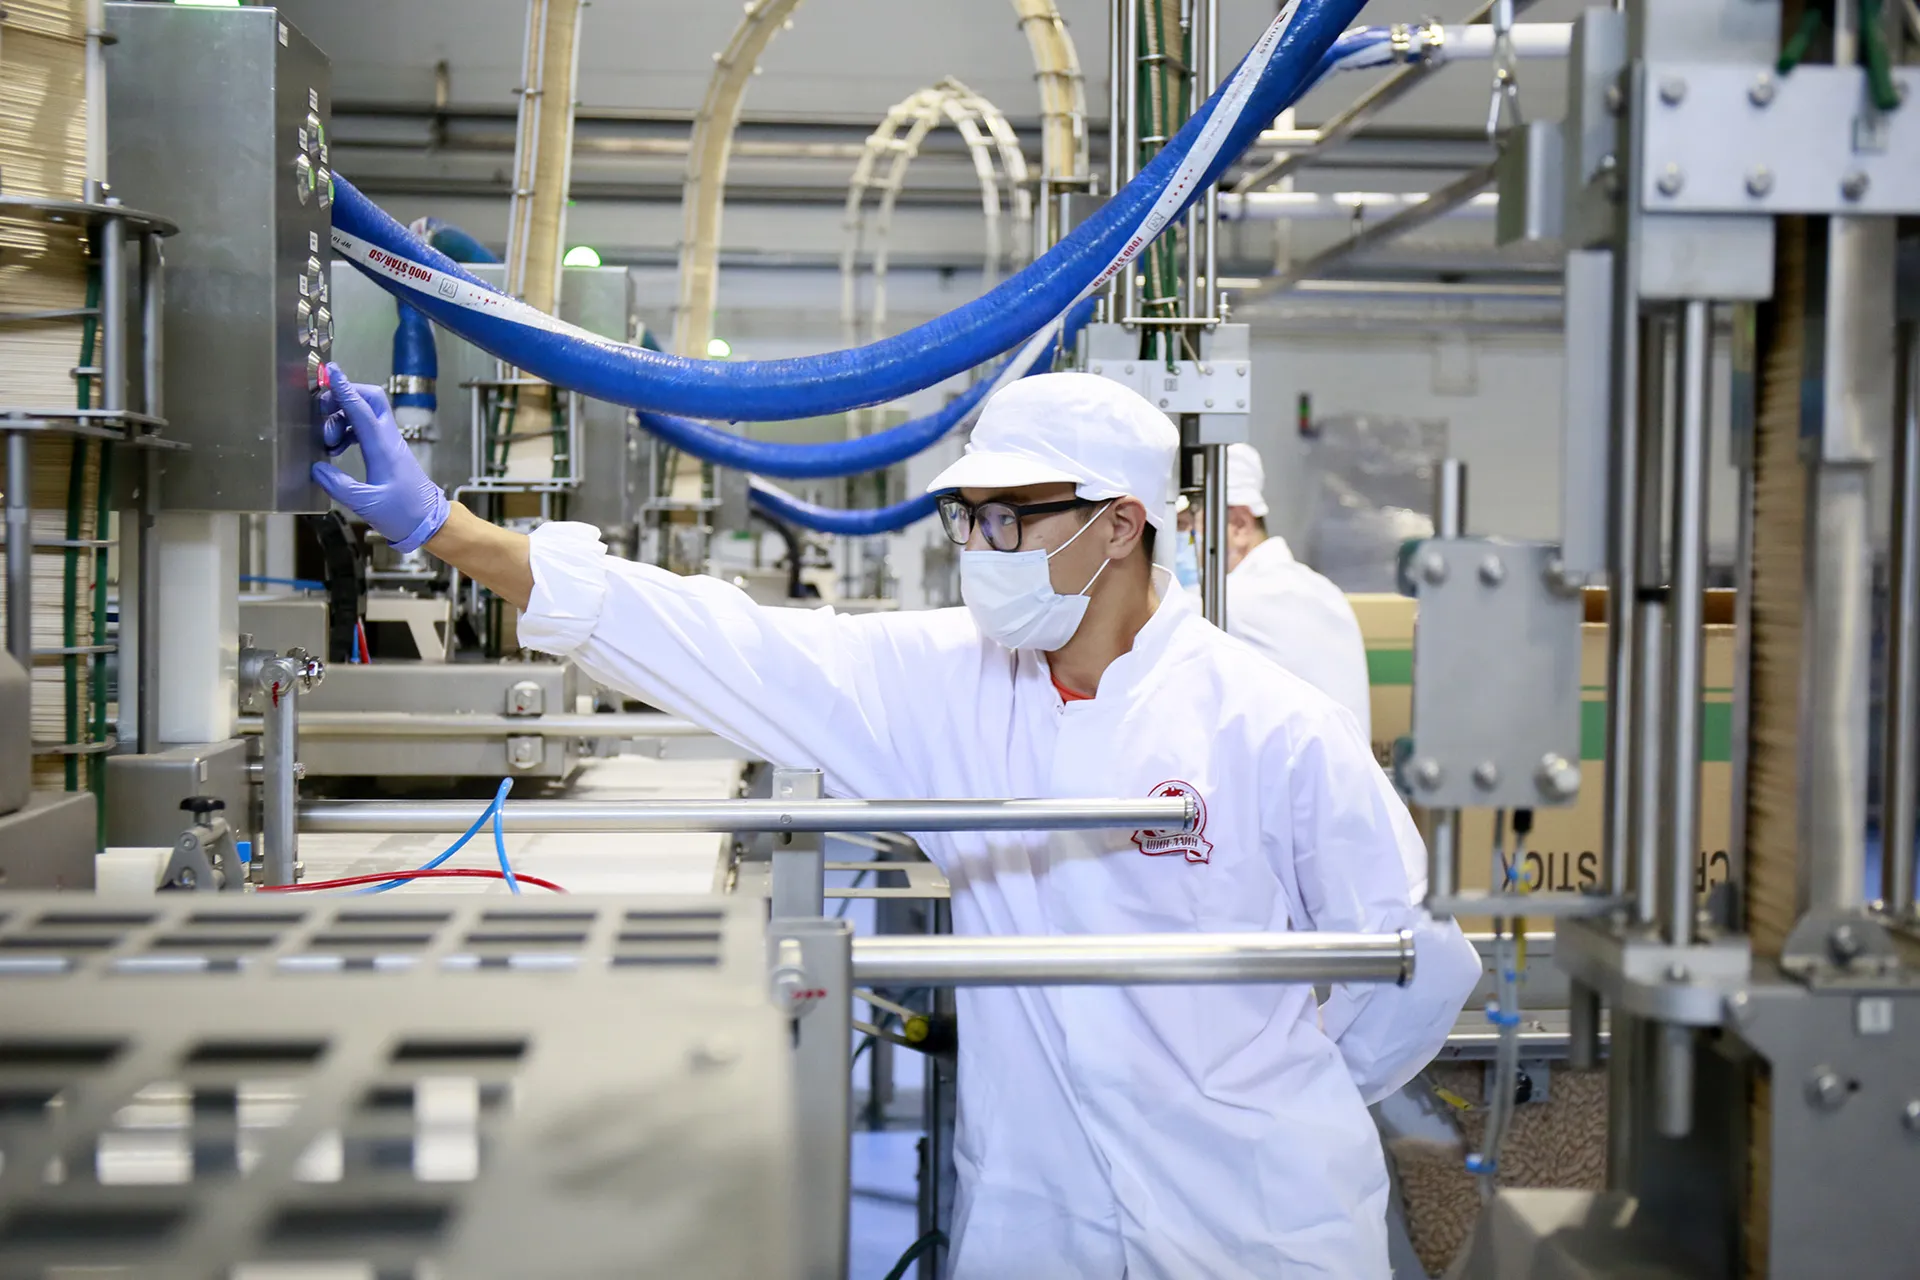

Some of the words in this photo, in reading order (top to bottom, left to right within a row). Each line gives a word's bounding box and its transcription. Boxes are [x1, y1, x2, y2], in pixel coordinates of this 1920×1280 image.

[1123, 236, 1143, 257] FOOD
[368, 249, 407, 273] STAR/SD
[1092, 257, 1125, 287] STAR/SD
[408, 266, 433, 283] FOOD
[1501, 851, 1598, 893] STICK
